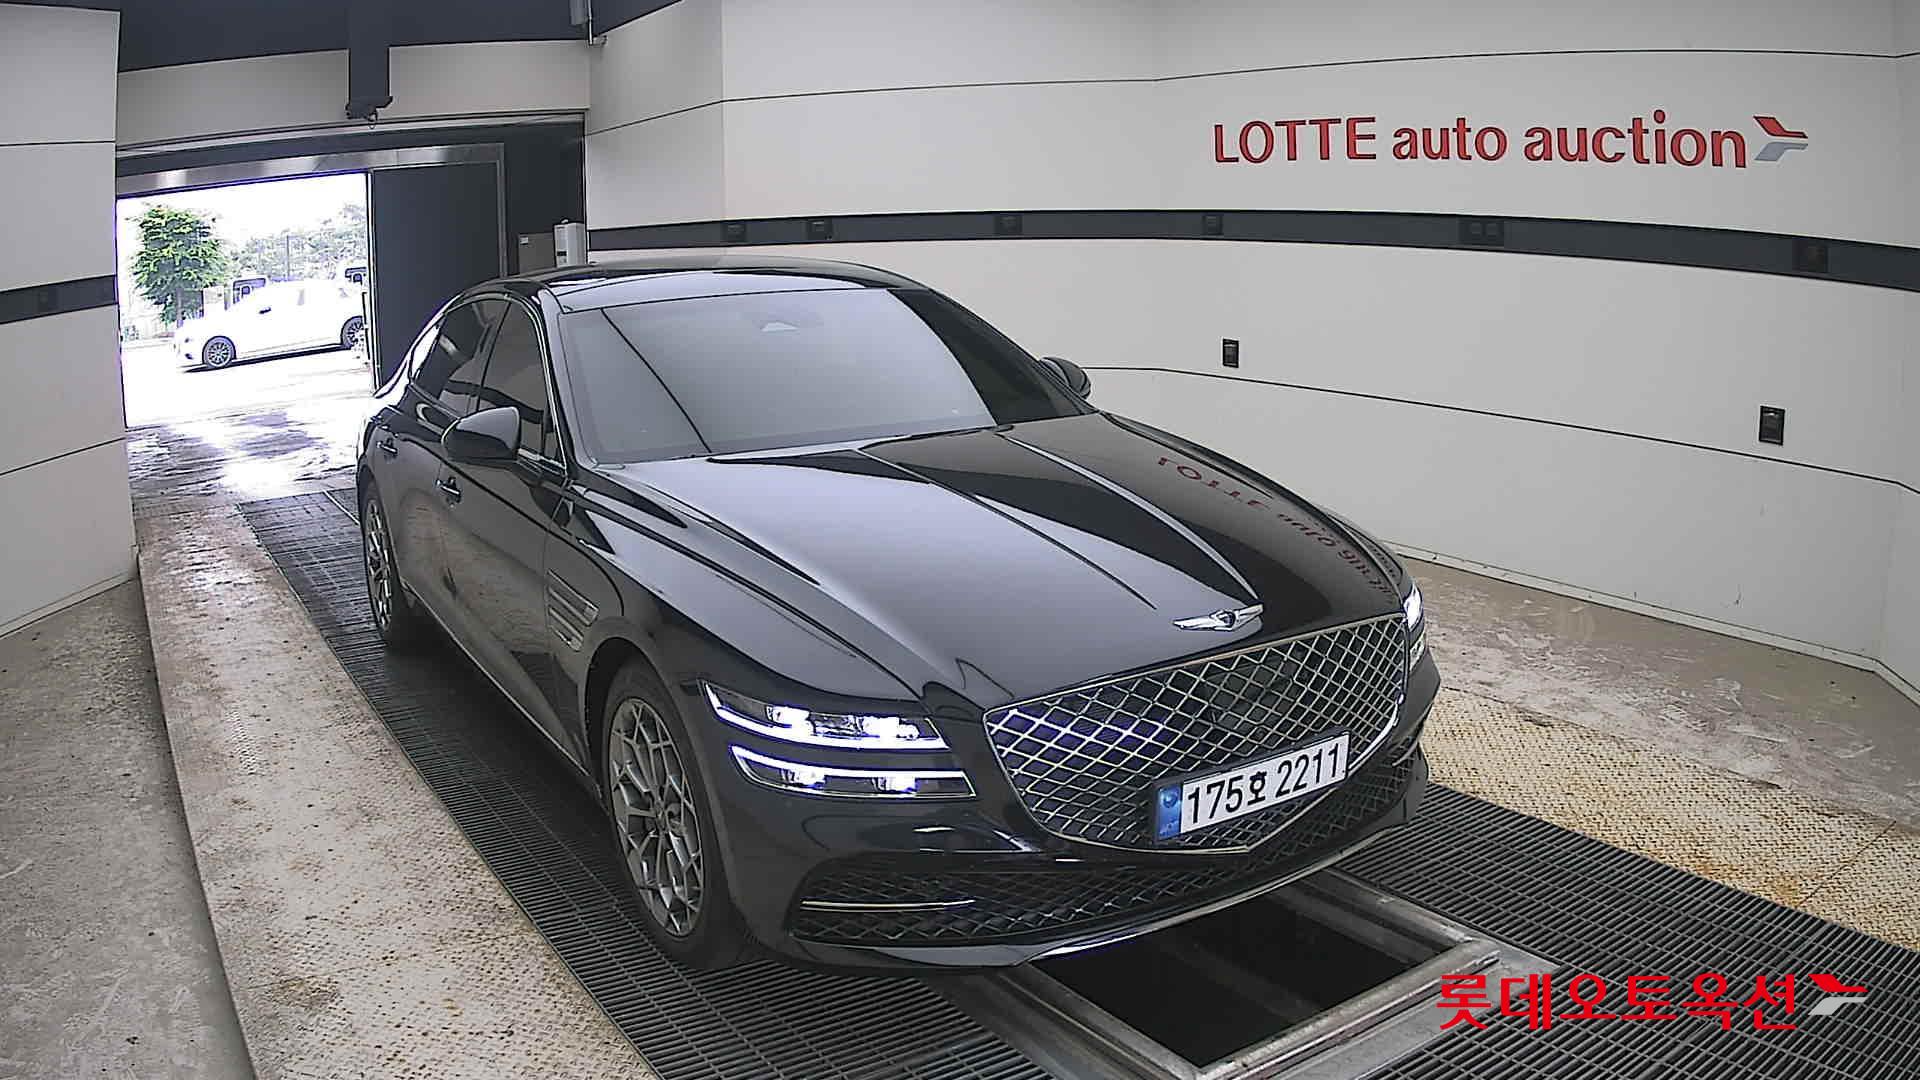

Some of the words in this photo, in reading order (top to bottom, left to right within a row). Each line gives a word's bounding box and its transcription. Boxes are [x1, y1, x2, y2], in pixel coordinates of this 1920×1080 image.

[1213, 116, 1377, 164] LOTTE
[1391, 117, 1508, 162] auto
[1523, 109, 1747, 168] auction
[1187, 771, 1267, 826] 175호
[1275, 742, 1340, 799] 2211
